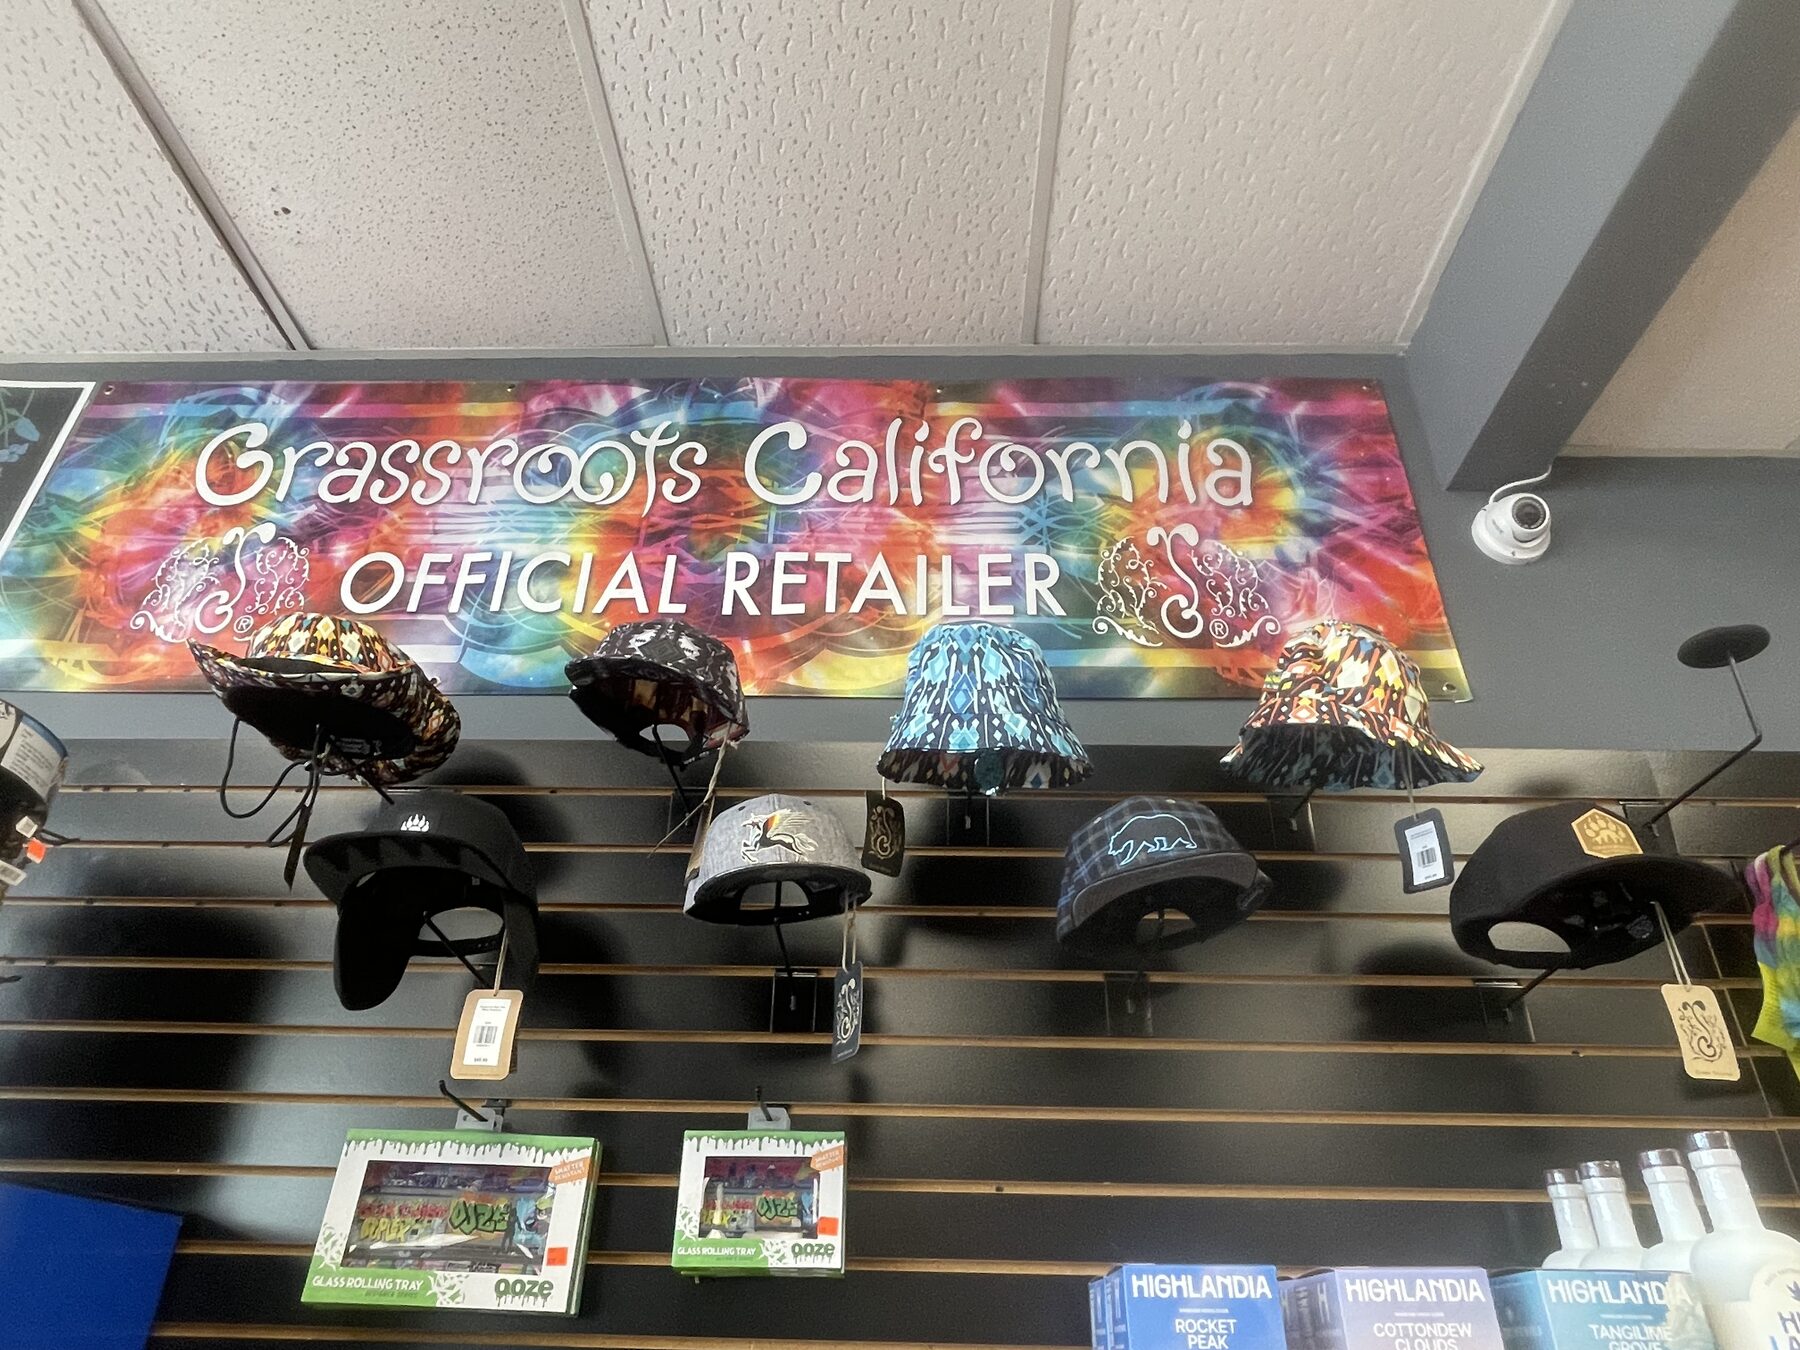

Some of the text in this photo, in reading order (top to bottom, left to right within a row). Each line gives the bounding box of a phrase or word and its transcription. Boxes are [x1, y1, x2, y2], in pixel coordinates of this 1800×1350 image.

[195, 416, 1252, 518] Grassroots California
[340, 550, 1067, 616] OFFICIAL RETAILER
[677, 1246, 756, 1256] GLASS ROLLING TRAY
[791, 1243, 836, 1259] ooze
[312, 1275, 424, 1291] GLASS ROLLING TRAY
[495, 1278, 554, 1300] ooze
[1131, 1273, 1273, 1299] HIGHLANDIA
[1344, 1278, 1486, 1303] HIGHLANDIA
[1175, 1319, 1237, 1335] ROCKET
[1373, 1323, 1472, 1338] COTTONDEW
[1188, 1335, 1229, 1350] PEAK
[1394, 1338, 1458, 1350] CLOUDS
